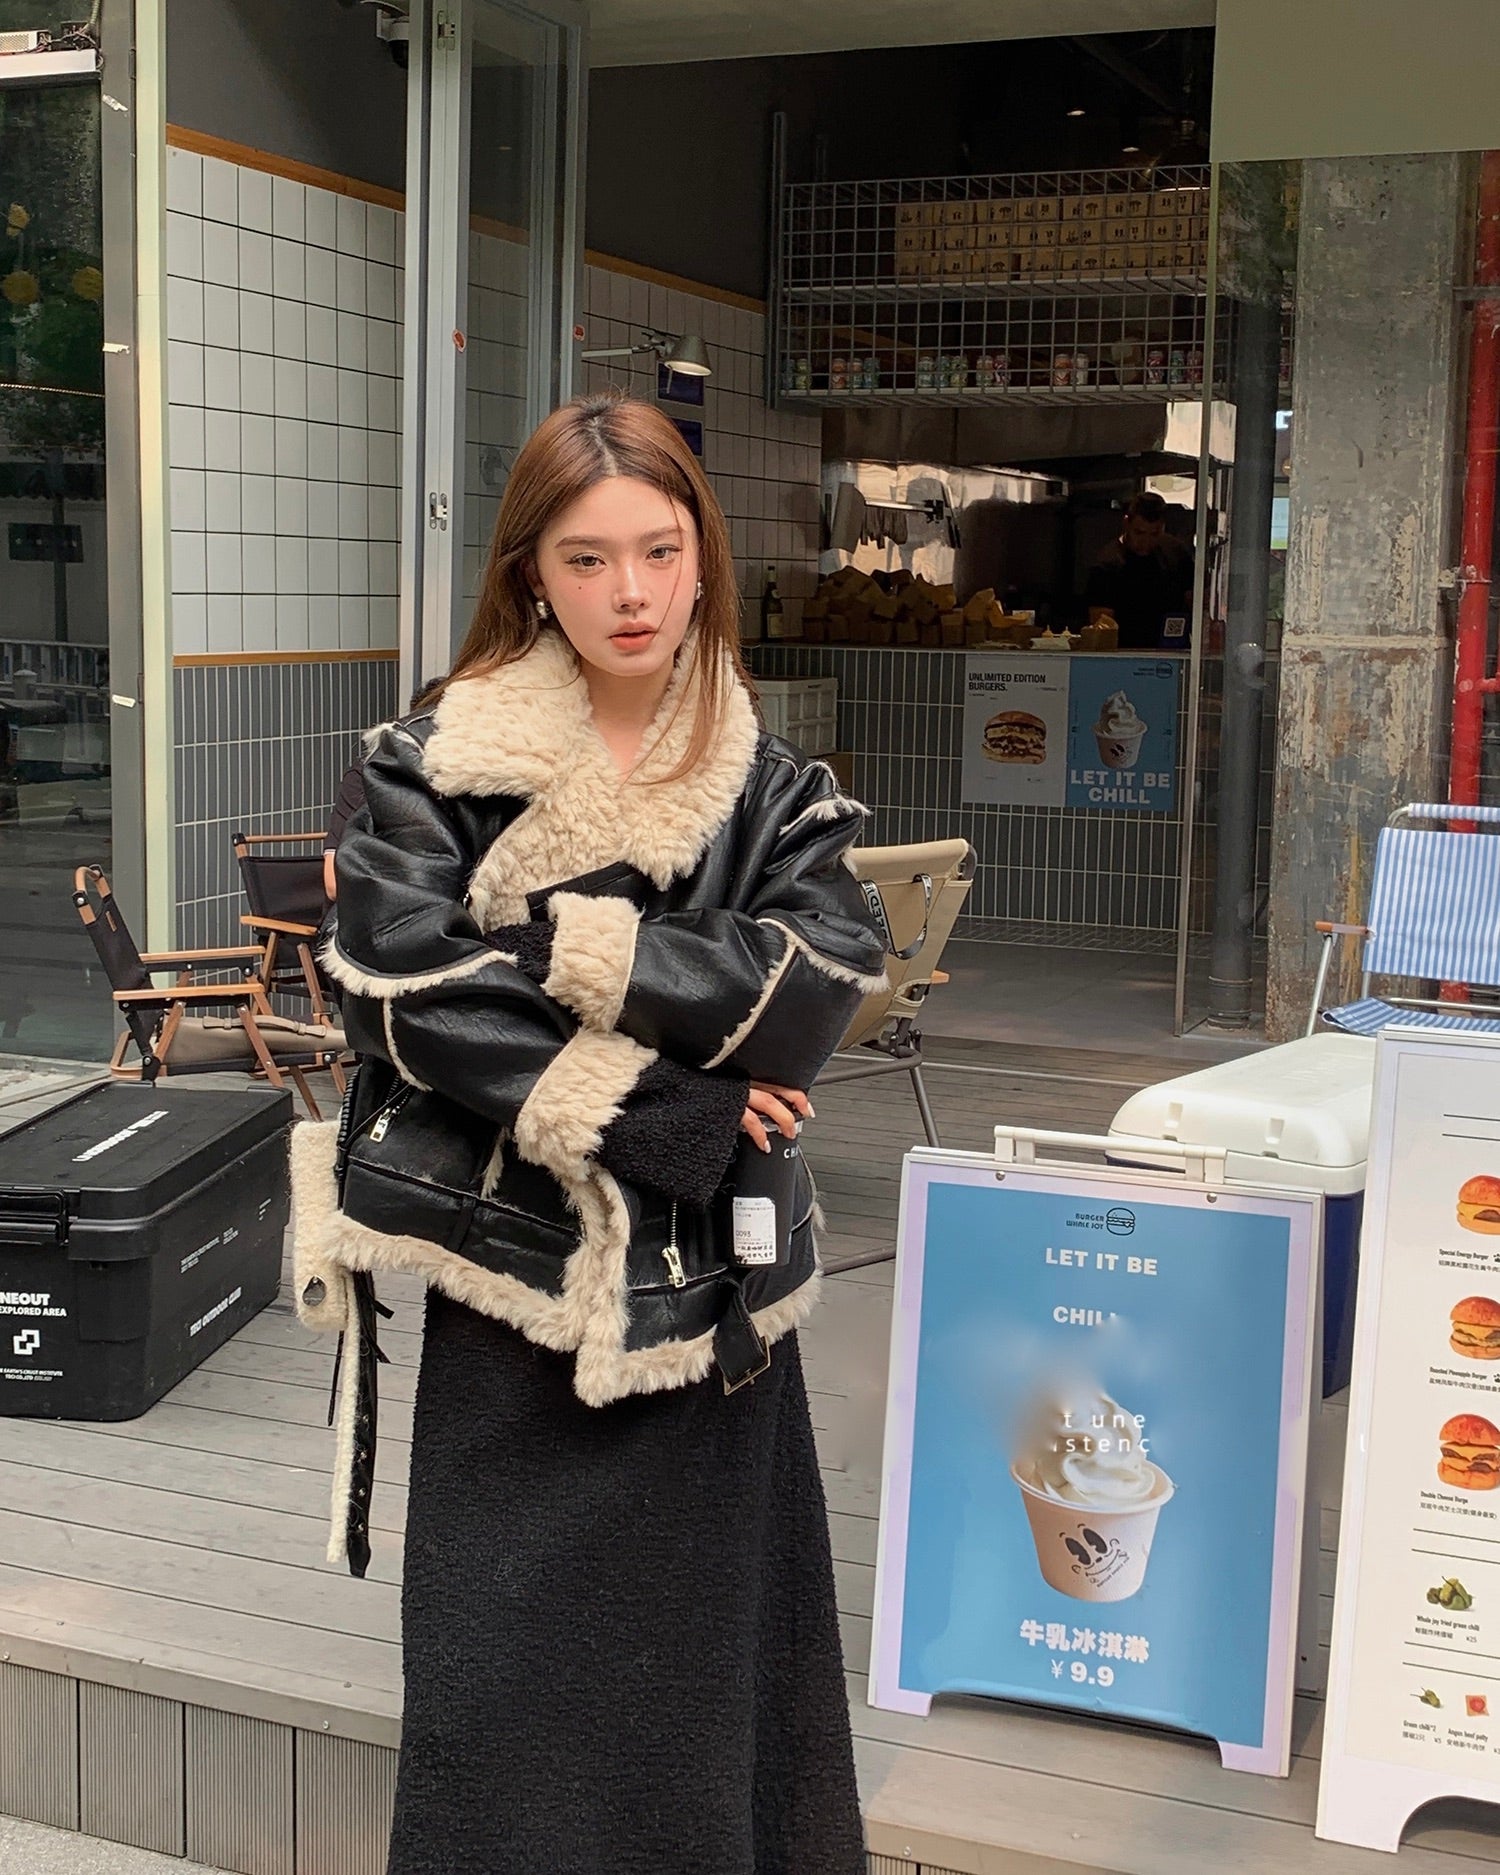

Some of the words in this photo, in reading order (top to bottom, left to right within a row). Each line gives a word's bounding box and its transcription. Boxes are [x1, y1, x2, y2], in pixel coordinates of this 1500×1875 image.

[969, 673, 1012, 682] UNLIMITED
[1014, 674, 1046, 683] EDITION
[969, 682, 1008, 691] BURGERS.
[1070, 769, 1109, 786] LET
[1116, 771, 1136, 787] IT
[1143, 772, 1171, 788] BE
[1088, 787, 1151, 804] CHILL
[1075, 1213, 1105, 1222] BURGER
[1046, 1247, 1088, 1268] LET
[1096, 1252, 1119, 1271] IT
[1127, 1256, 1158, 1276] BE
[43, 1307, 67, 1317] AREA
[1472, 1372, 1487, 1380] Burger
[1420, 1490, 1436, 1499] Double
[1437, 1493, 1454, 1502] Cheese
[1020, 1619, 1149, 1663] 牛乳冰淇淋
[1403, 1719, 1418, 1728] Green
[1448, 1728, 1463, 1737] Angus
